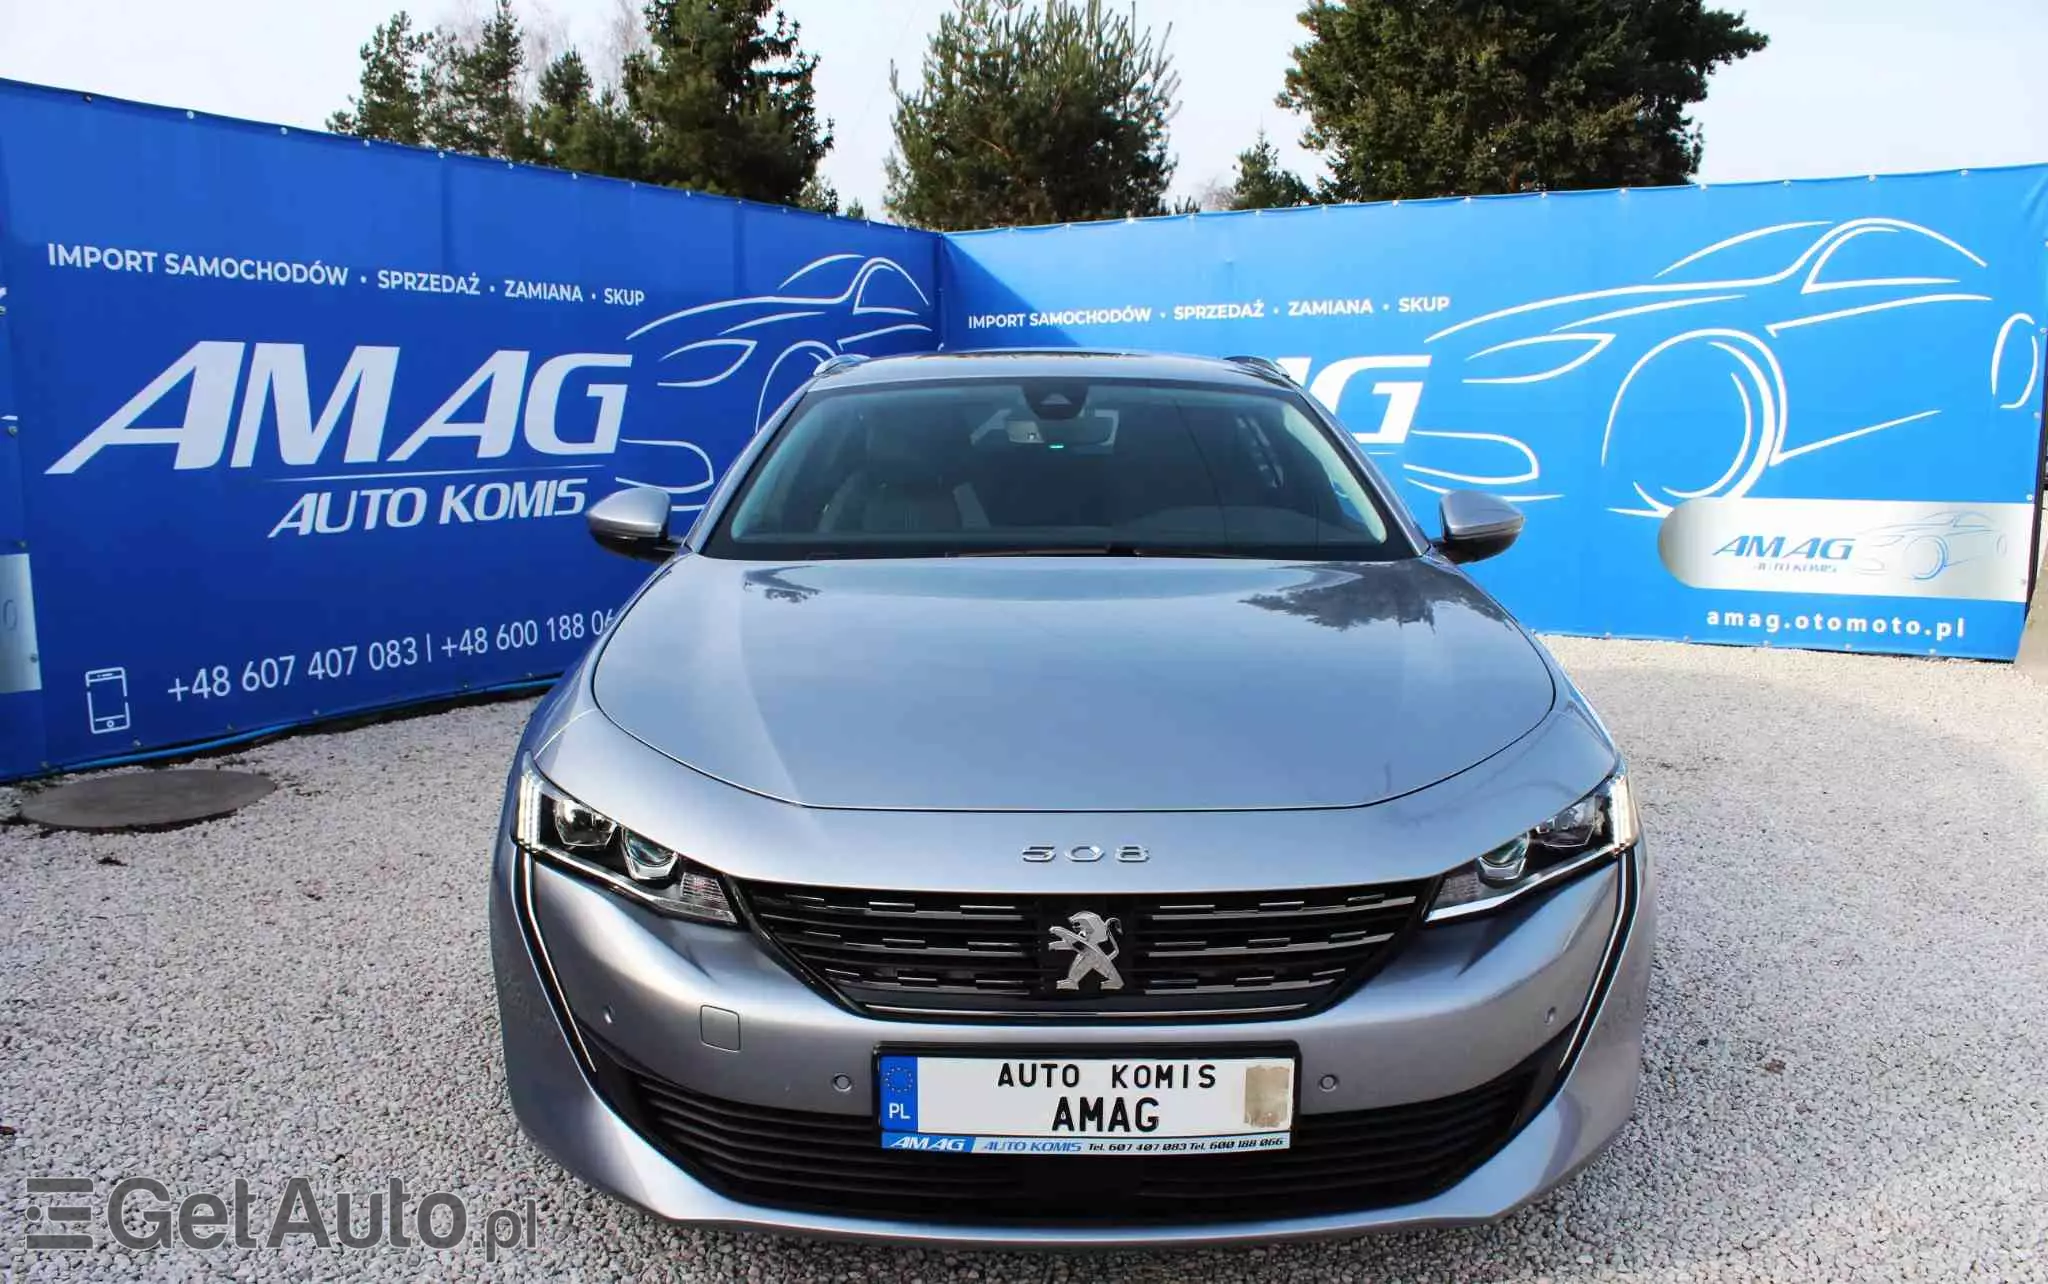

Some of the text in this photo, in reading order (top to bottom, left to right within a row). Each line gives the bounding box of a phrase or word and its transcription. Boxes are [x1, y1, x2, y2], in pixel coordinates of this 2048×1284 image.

[47, 242, 645, 306] IMPORT SAMOCHODÓW SPRZEDAŻ ZAMIANA SKUP
[968, 296, 1450, 329] IMPORT SAMOCHODÓW SPRZEDAŻ ZAMIANA SKUP
[44, 340, 633, 474] AMAG
[268, 477, 588, 538] AUTO KOMIS
[1712, 535, 1856, 560] AMAG
[1706, 609, 1966, 640] amag.otomoto.pl
[167, 665, 231, 701] +48
[242, 655, 295, 692] 607
[307, 646, 358, 680] 407
[368, 637, 418, 671] 083
[441, 626, 488, 658] +48
[496, 619, 538, 651] 600
[546, 613, 585, 642] 188
[1022, 844, 1149, 863] 508
[998, 1063, 1217, 1089] AUTO KOMIS
[889, 1102, 911, 1120] PL
[1052, 1096, 1160, 1133] AMAG
[890, 1136, 966, 1151] AMAG
[984, 1141, 1027, 1151] AUTO
[1029, 1141, 1082, 1152] KOMIS
[1108, 1143, 1134, 1152] 607
[1135, 1142, 1160, 1152] 407
[1209, 1140, 1235, 1150] 600
[1237, 1139, 1258, 1149] 188
